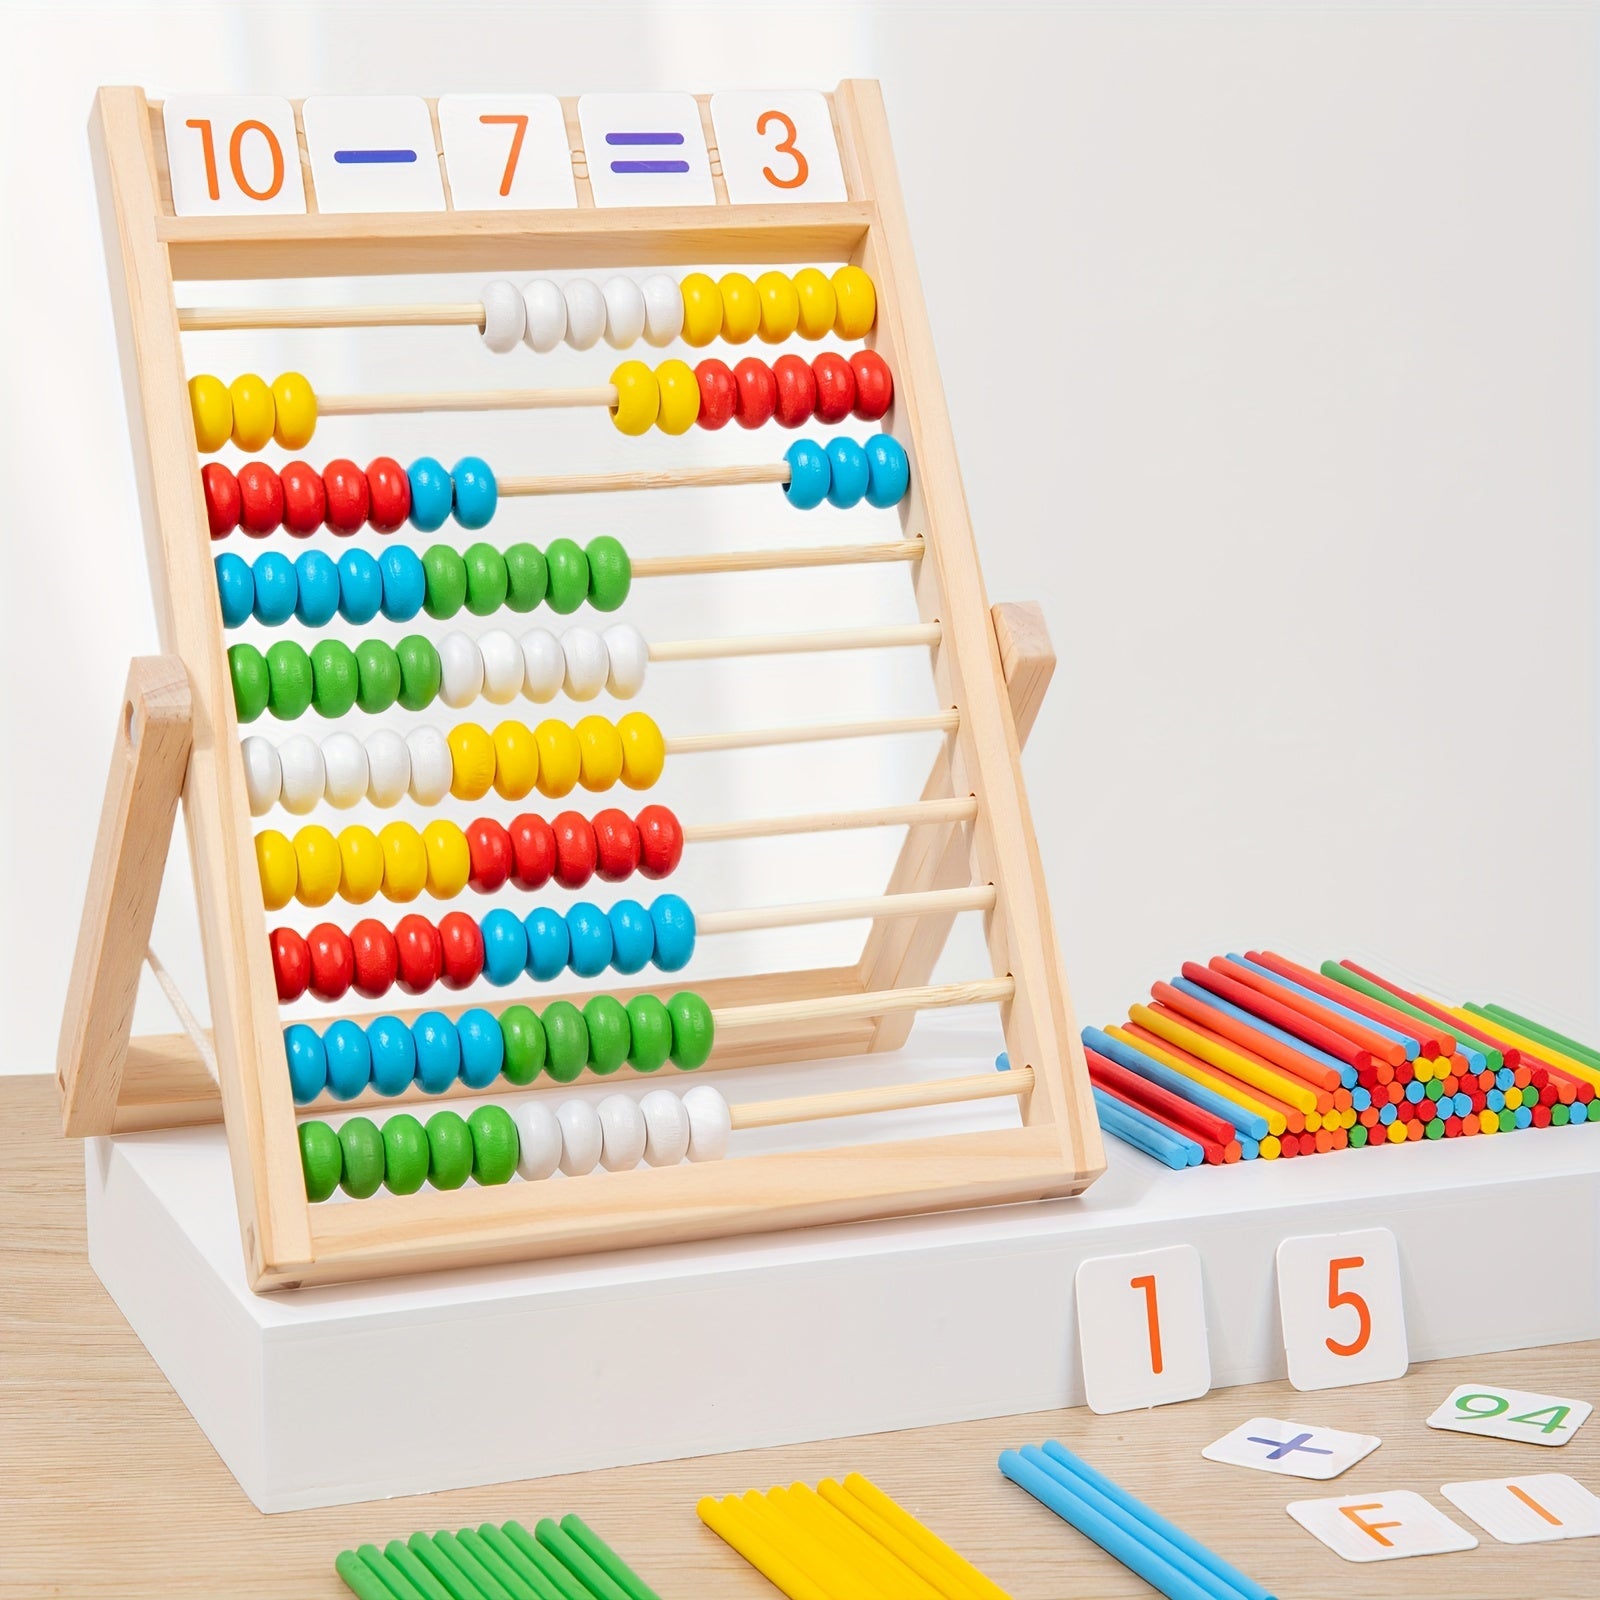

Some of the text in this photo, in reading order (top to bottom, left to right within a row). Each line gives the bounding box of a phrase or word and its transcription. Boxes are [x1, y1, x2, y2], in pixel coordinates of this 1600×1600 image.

[185, 118, 285, 202] 10
[478, 114, 529, 197] 7
[605, 132, 691, 174] =
[755, 109, 810, 190] 3
[1129, 1274, 1164, 1375] 1
[1324, 1255, 1373, 1358] 5
[1454, 1393, 1572, 1434] 94
[1338, 1502, 1403, 1548] F
